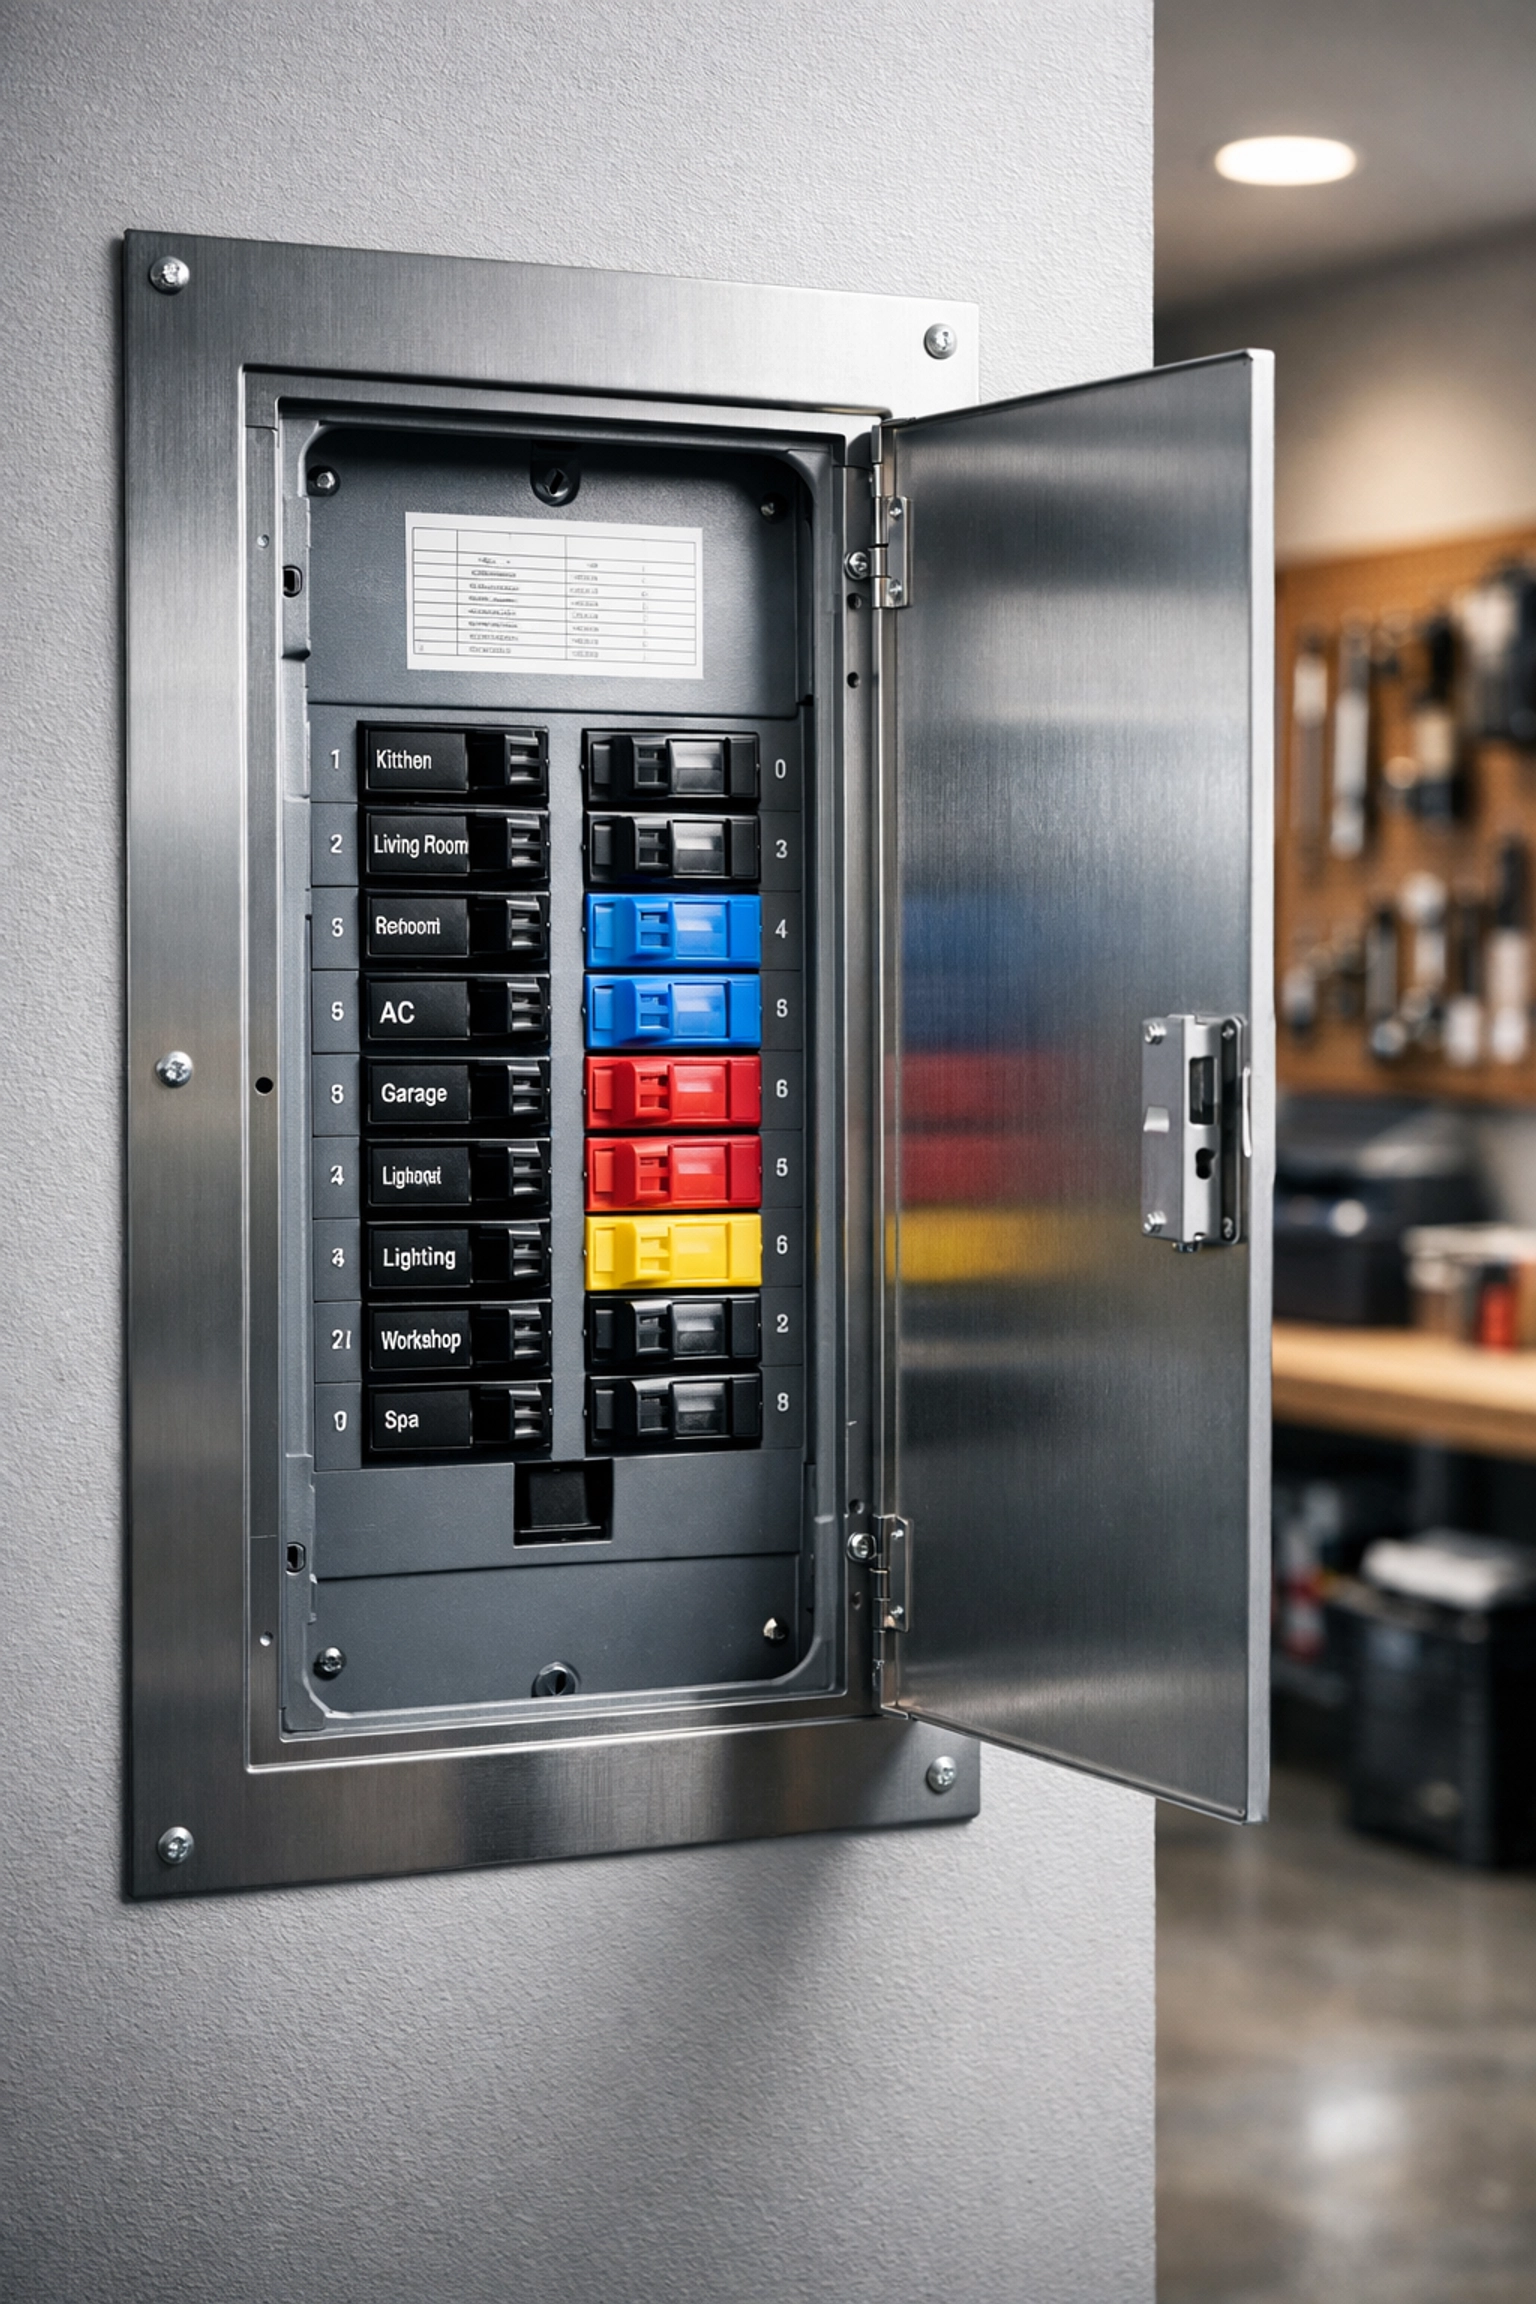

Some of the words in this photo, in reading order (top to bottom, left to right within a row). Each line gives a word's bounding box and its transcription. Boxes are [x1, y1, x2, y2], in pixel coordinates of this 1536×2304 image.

[331, 749, 340, 769] 1
[775, 758, 786, 779] 0
[330, 833, 343, 854] 2
[374, 833, 420, 859] Living
[424, 834, 469, 855] Room
[775, 839, 788, 859] 3
[775, 919, 788, 939] 4
[379, 1001, 415, 1024] AC
[381, 1082, 448, 1107] Garage
[383, 1246, 456, 1270] Lighting
[776, 1313, 789, 1333] 2
[381, 1328, 462, 1354] Workshop
[384, 1410, 420, 1433] Spa
